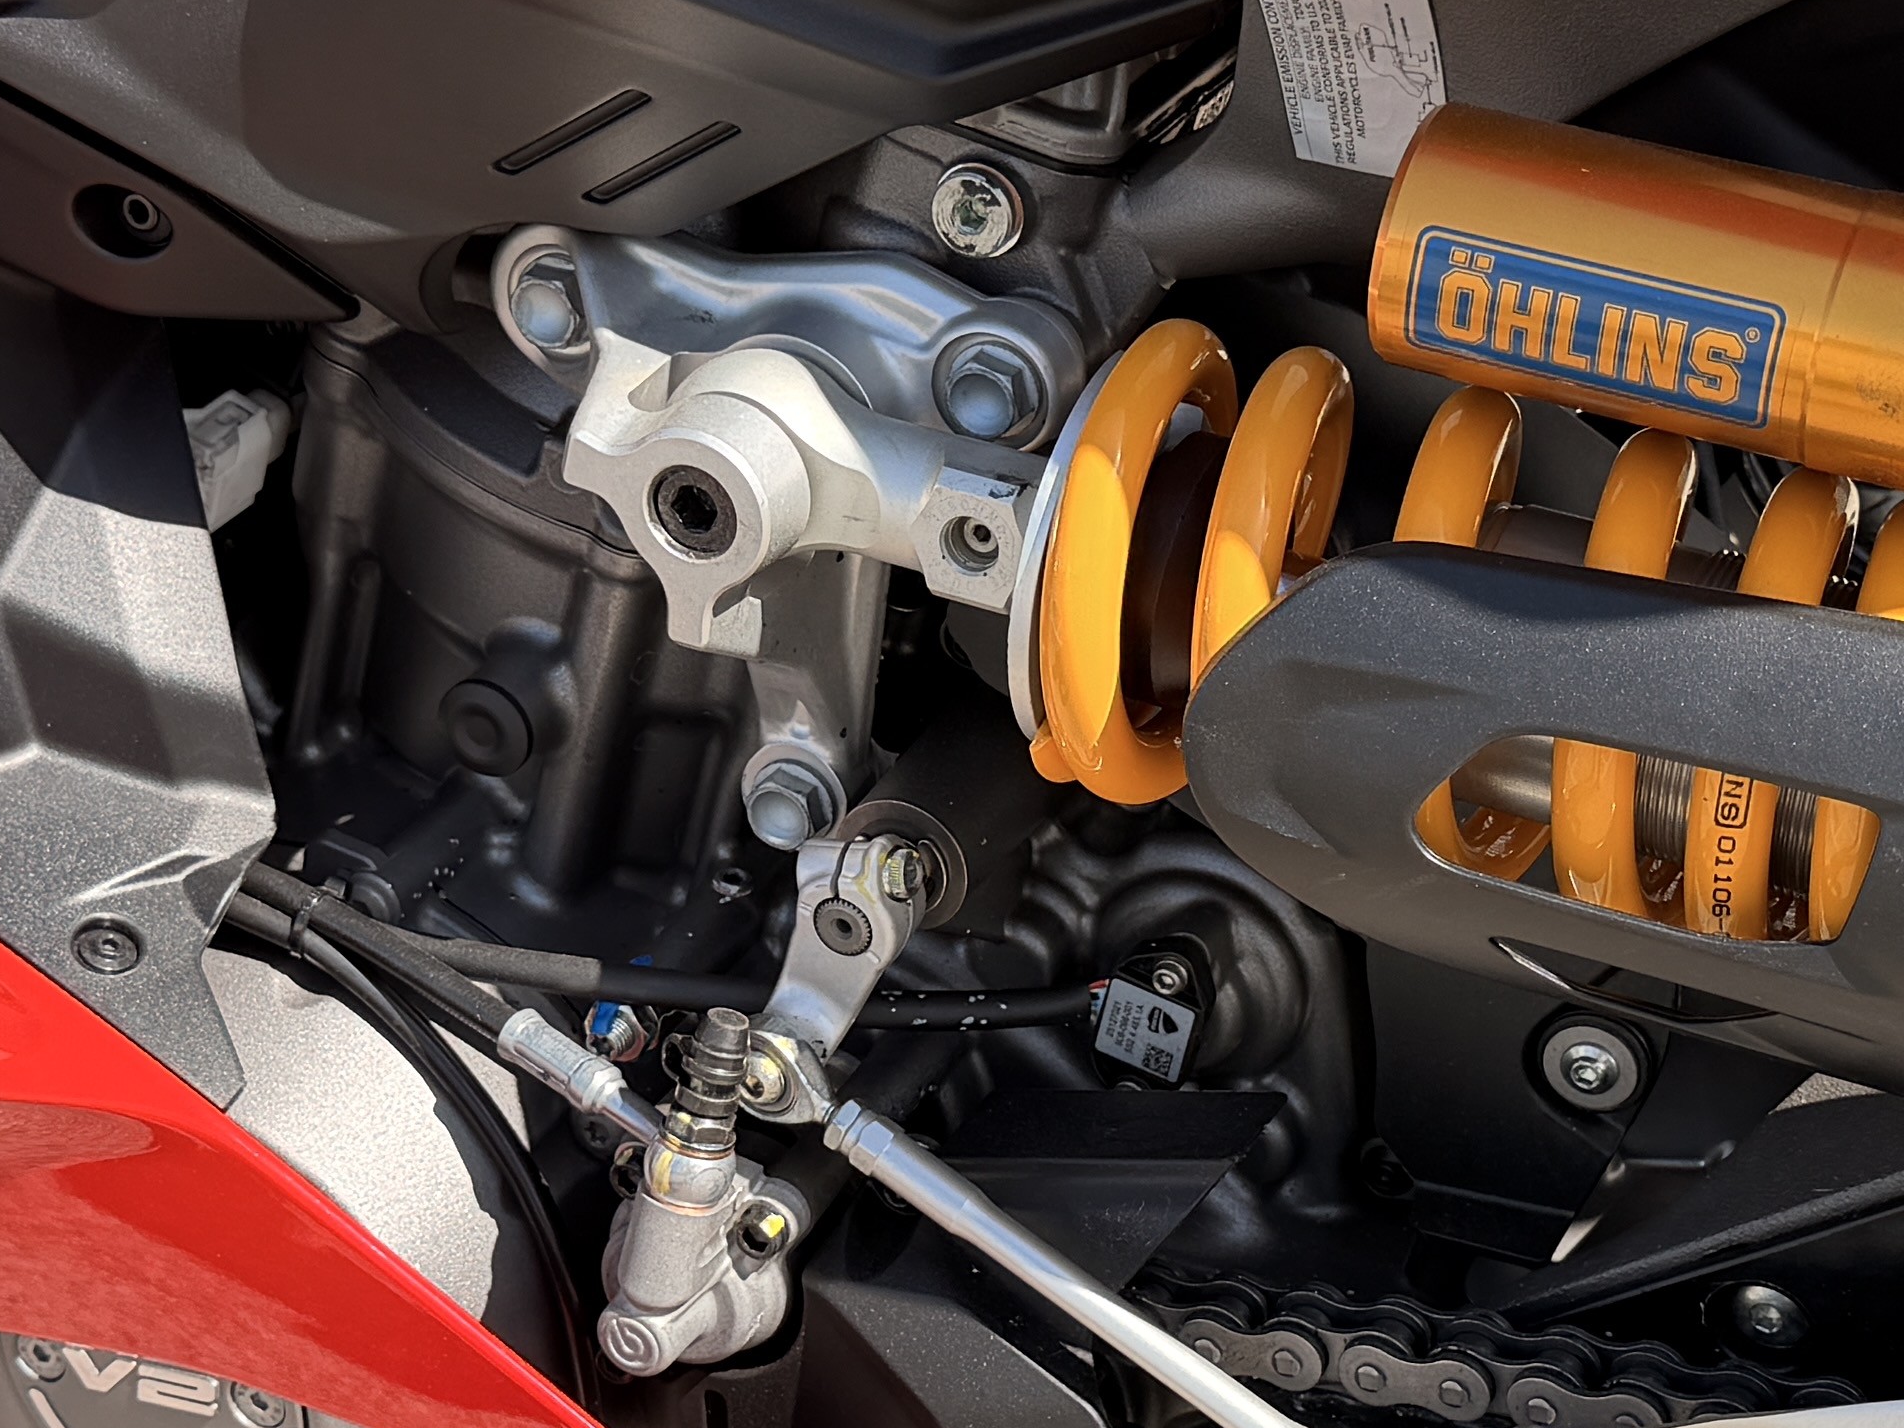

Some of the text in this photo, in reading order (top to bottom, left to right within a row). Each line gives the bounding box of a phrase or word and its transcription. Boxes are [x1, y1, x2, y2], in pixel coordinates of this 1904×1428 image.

[1310, 20, 1321, 31] TO
[1323, 14, 1333, 24] TO
[1271, 28, 1293, 82] EMISSION
[1313, 36, 1333, 92] CONFORMS
[1325, 28, 1346, 88] APPLICABLE
[1338, 34, 1354, 59] EVAP
[1296, 62, 1311, 99] ENGINE
[1308, 64, 1324, 102] ENGINE
[1346, 62, 1366, 138] MOTORCYCLES
[1285, 87, 1303, 135] VEHICLE
[1326, 96, 1341, 139] VEHICLE
[1338, 91, 1357, 164] REGULATIONS
[1332, 142, 1344, 164] THIS
[1435, 246, 1745, 406] ÖHLINS
[1711, 835, 1737, 938] 01106-
[62, 1347, 219, 1417] V2
